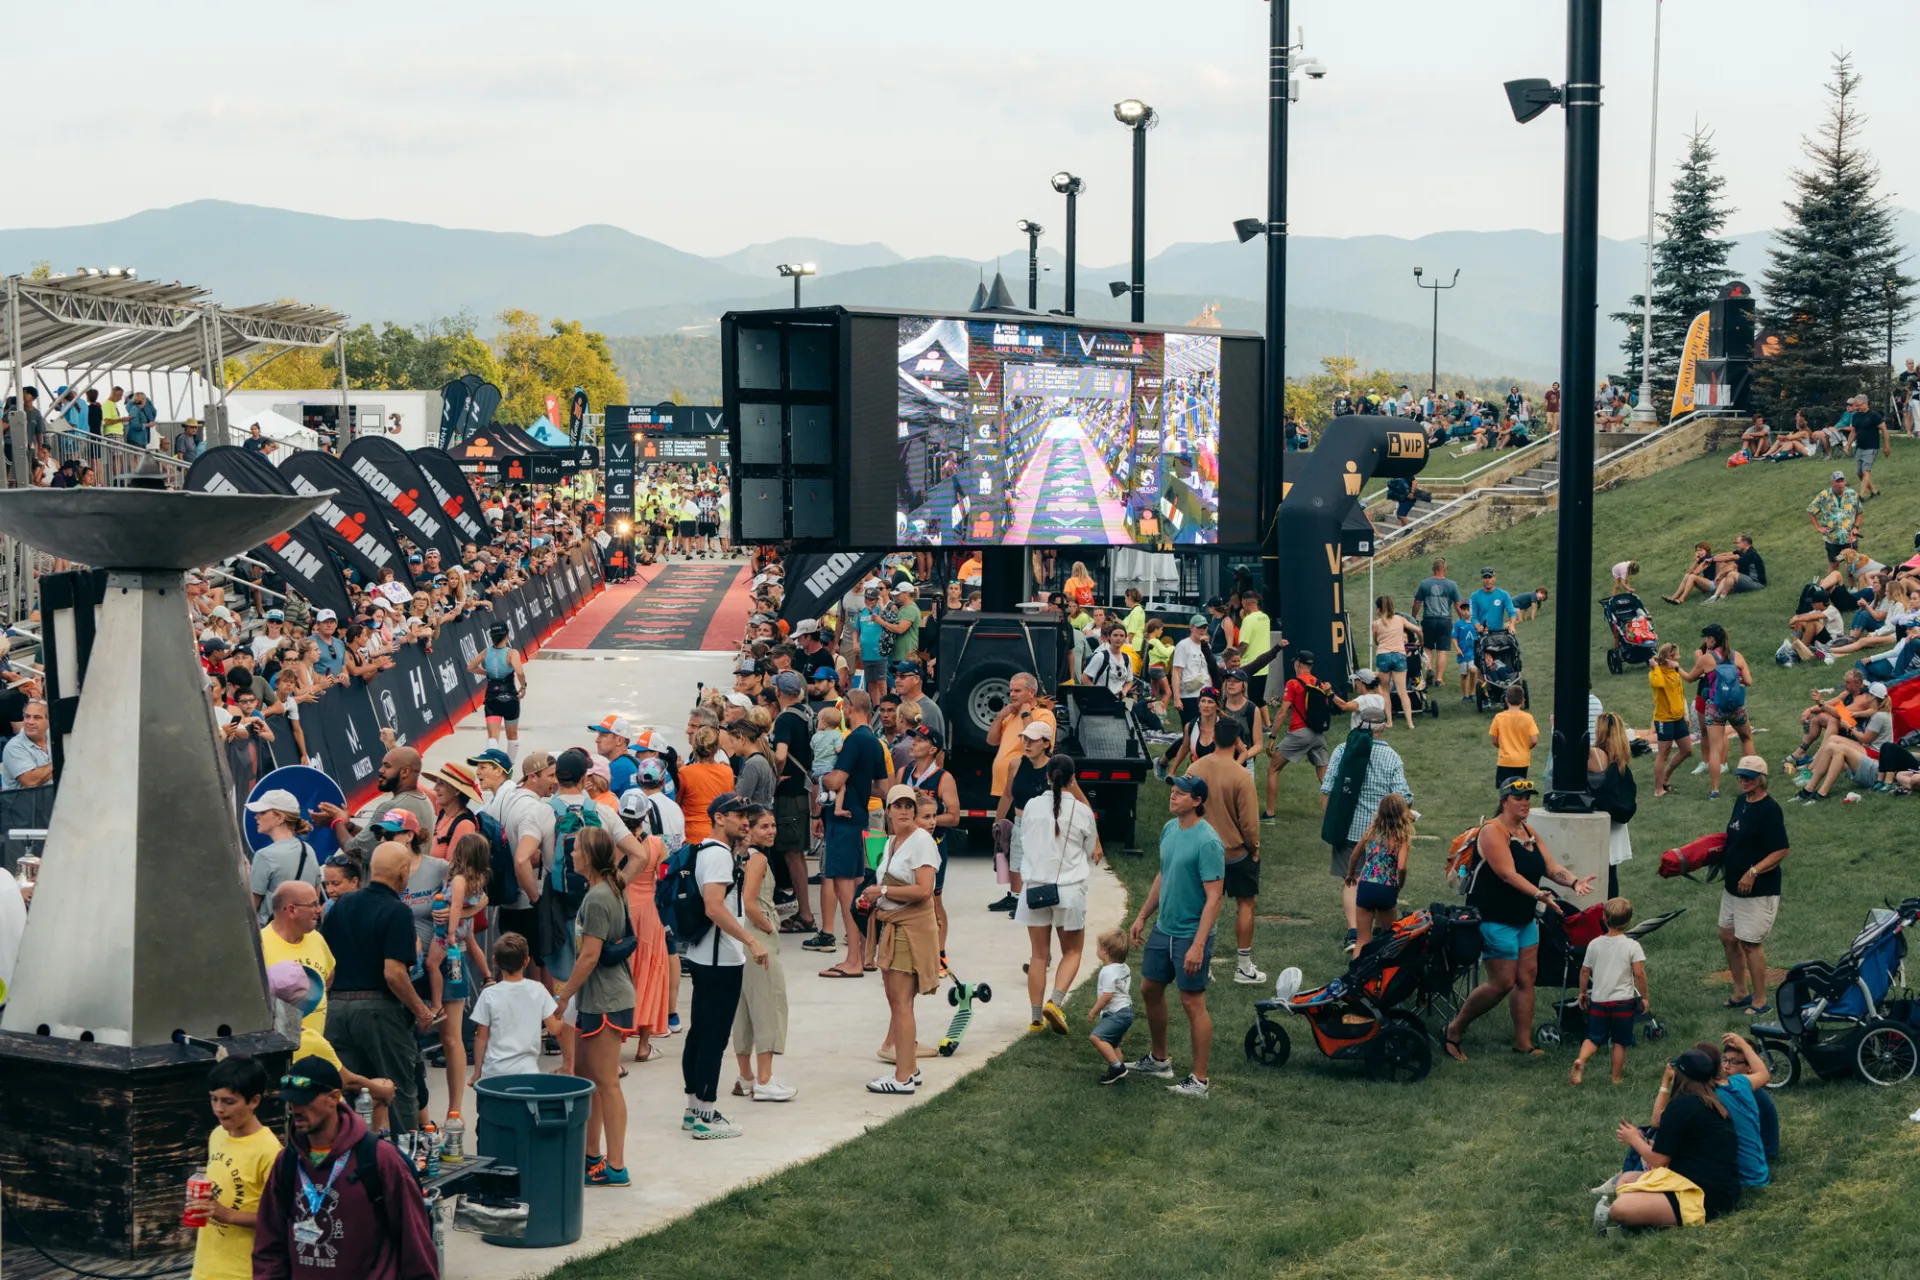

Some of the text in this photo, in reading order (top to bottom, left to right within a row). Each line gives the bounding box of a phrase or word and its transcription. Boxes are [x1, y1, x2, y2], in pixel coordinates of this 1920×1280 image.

[1096, 343, 1130, 351] VINFAST
[1137, 429, 1160, 439] HOKA
[1403, 438, 1422, 453] VIP
[459, 461, 499, 473] RONMAN
[351, 456, 441, 539] IRONMAN
[225, 1157, 233, 1167] &
[230, 1168, 245, 1211] DEANNA
[299, 1255, 336, 1268] NEW YORK
